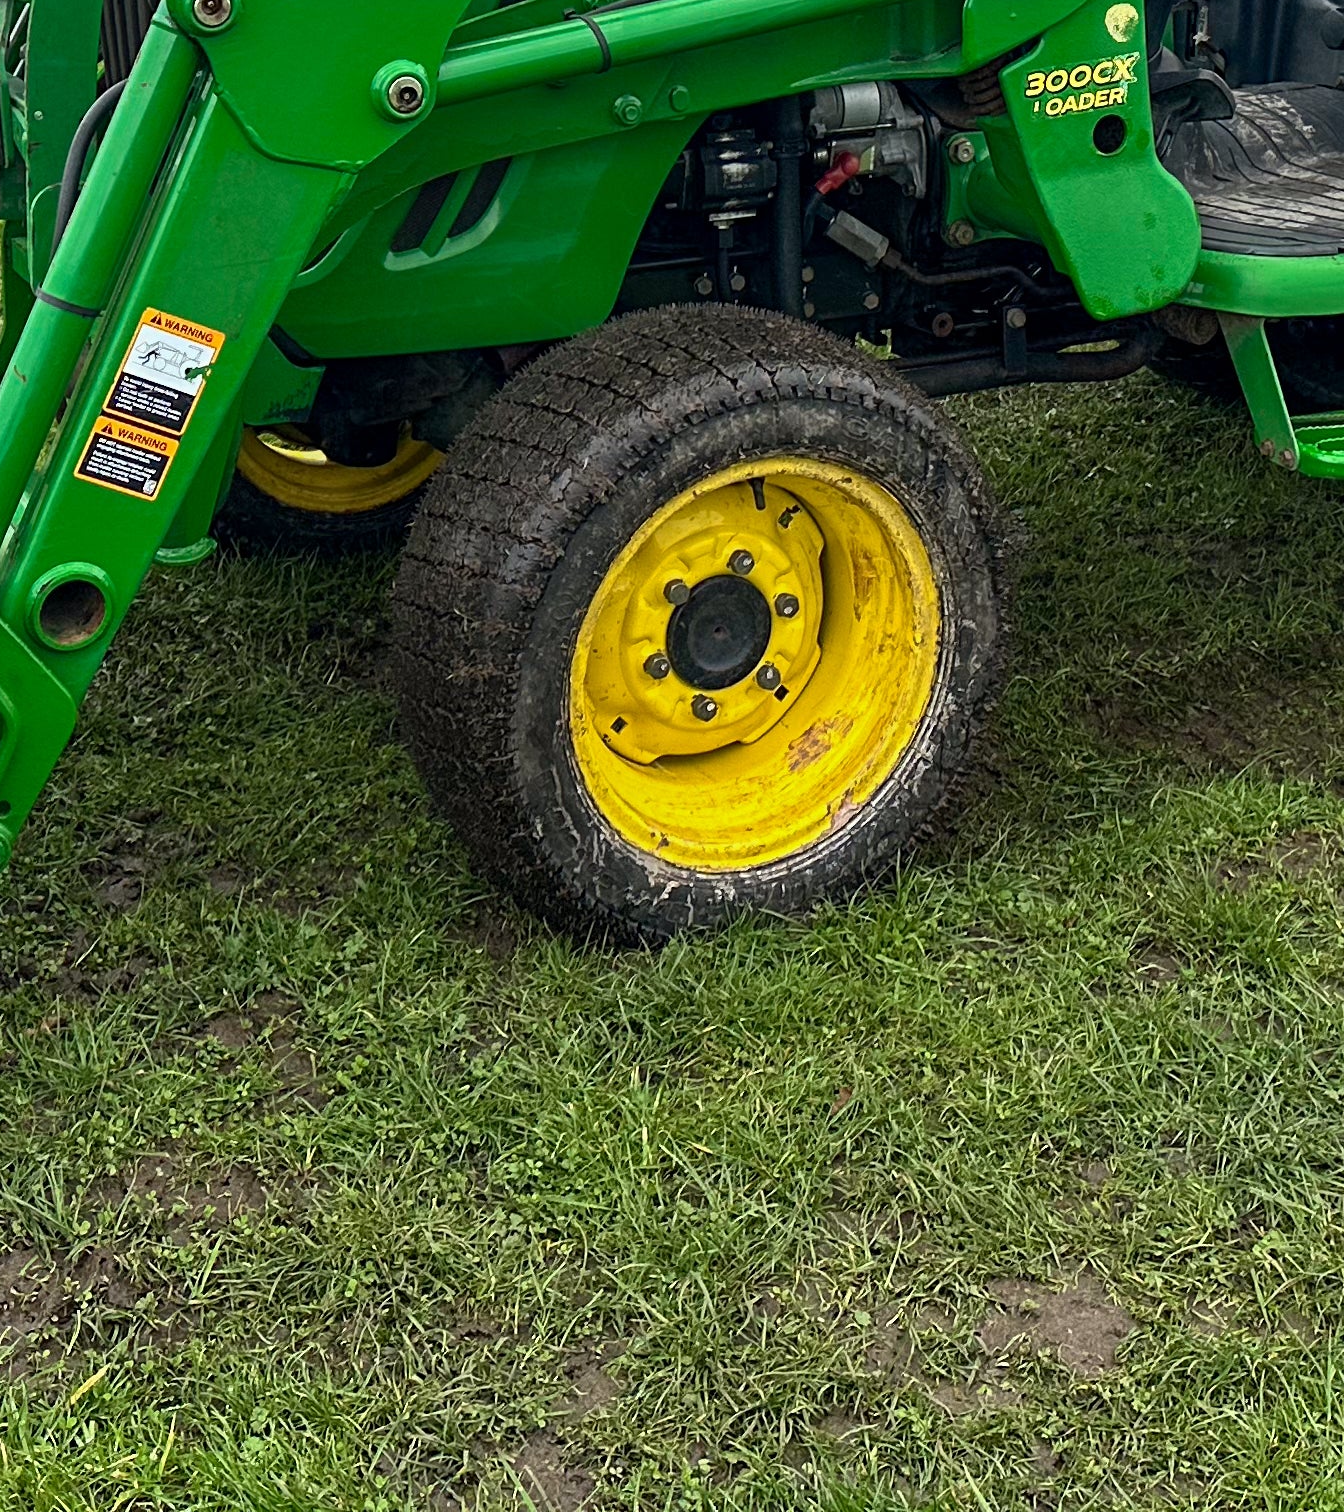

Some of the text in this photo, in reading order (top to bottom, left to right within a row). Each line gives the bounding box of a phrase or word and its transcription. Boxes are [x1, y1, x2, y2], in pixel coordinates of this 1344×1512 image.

[1024, 53, 1139, 97] 300CX
[164, 319, 214, 343] WARNING
[118, 428, 168, 451] WARNING
